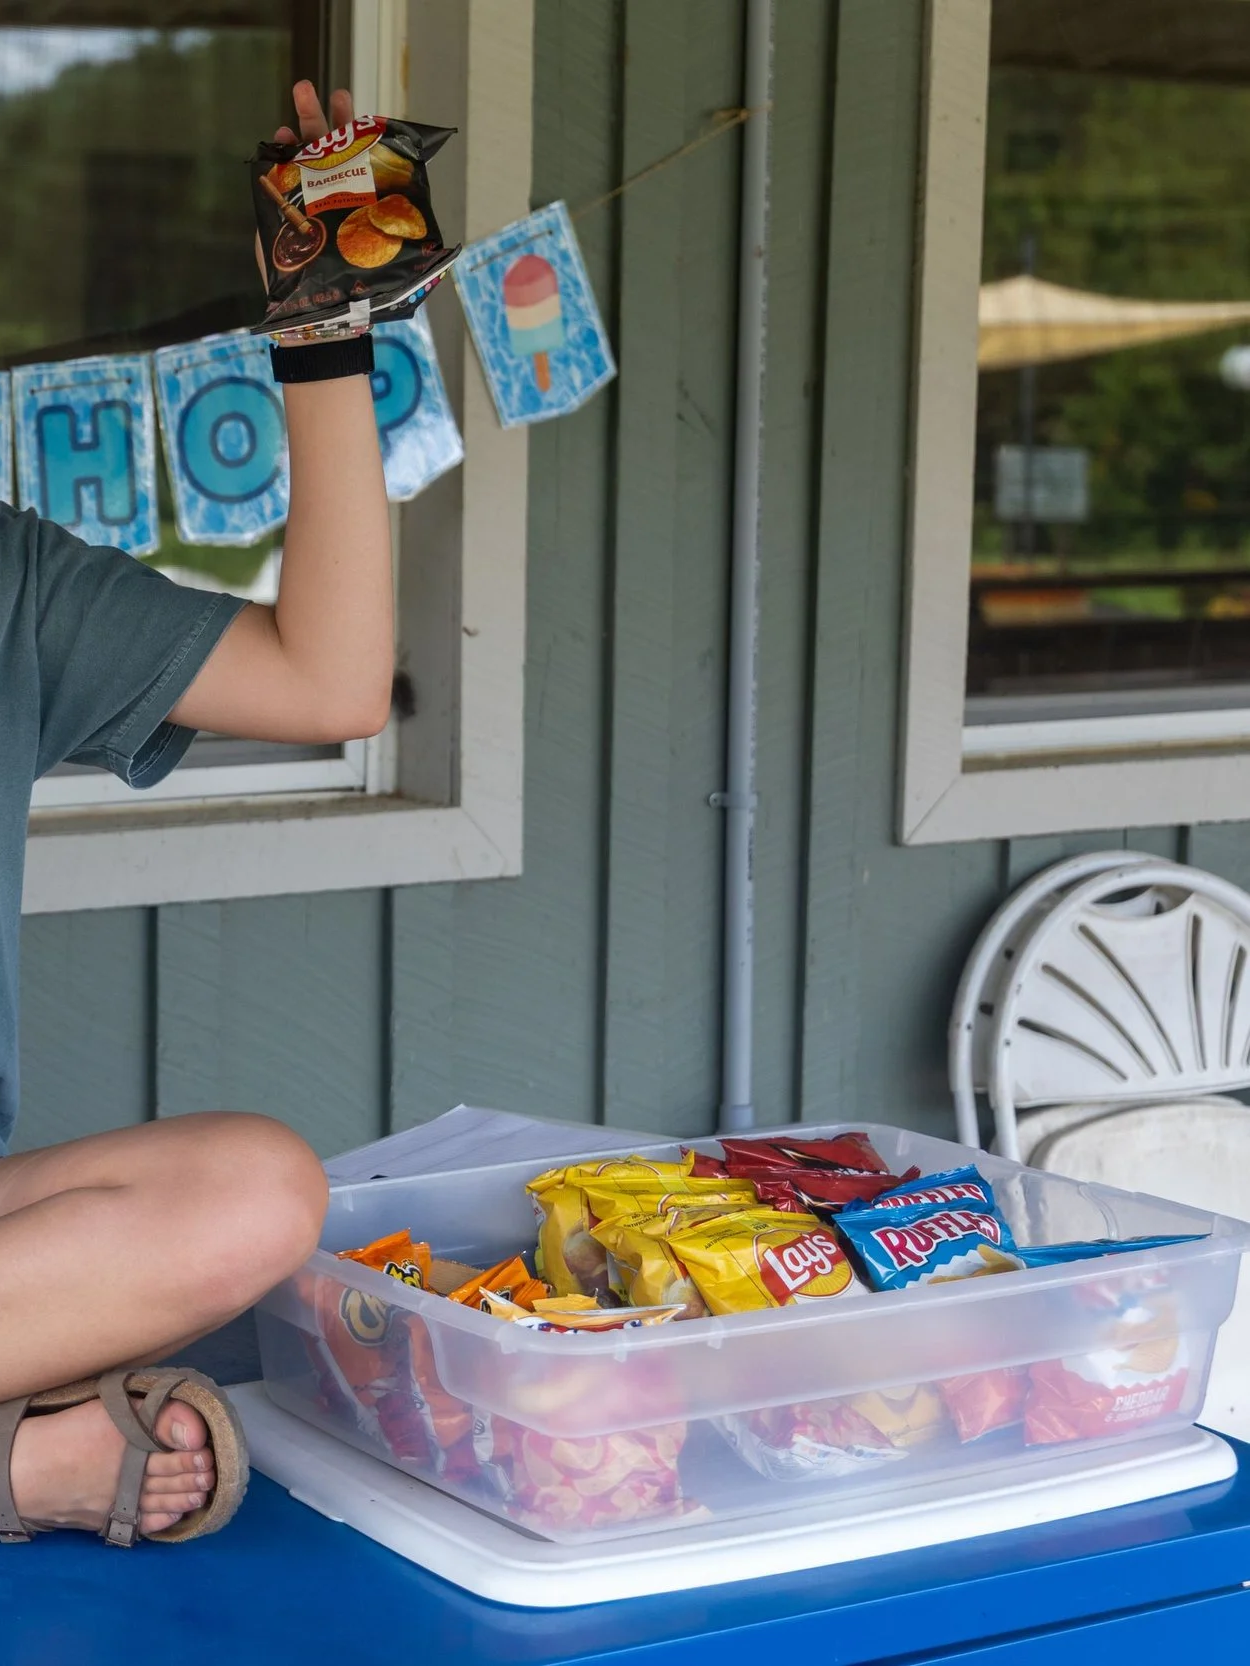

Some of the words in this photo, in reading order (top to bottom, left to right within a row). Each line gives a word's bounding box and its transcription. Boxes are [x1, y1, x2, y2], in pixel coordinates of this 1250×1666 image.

[307, 167, 368, 188] BARBECUE
[764, 1233, 838, 1292] Lay's
[871, 1210, 1001, 1271] RUFFLES
